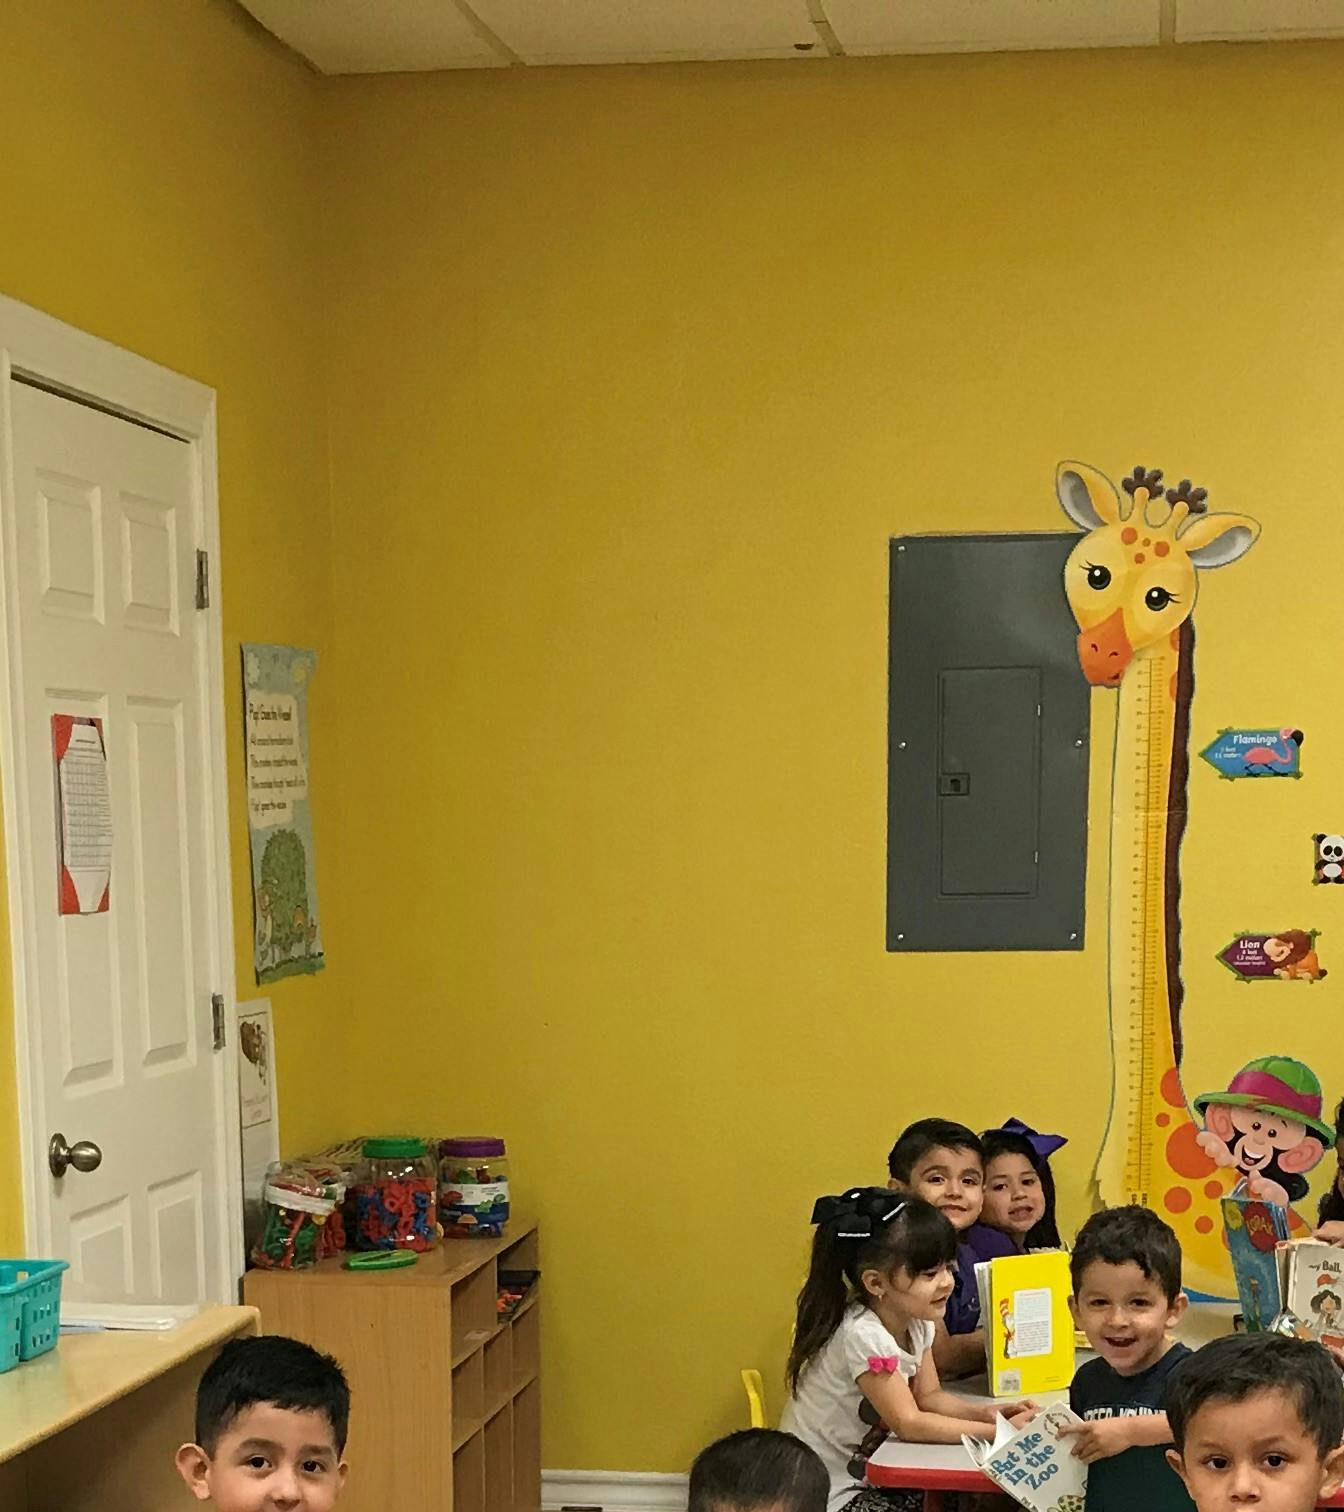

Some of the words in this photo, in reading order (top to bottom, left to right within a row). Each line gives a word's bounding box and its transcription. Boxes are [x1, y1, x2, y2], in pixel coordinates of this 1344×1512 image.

[1233, 734, 1277, 746] Flamingo
[1240, 940, 1261, 949] Lion
[990, 1449, 1020, 1475] Put
[1015, 1431, 1044, 1456] Me
[1004, 1465, 1029, 1487] in
[1025, 1444, 1056, 1469] the
[1024, 1463, 1060, 1491] Zoo
